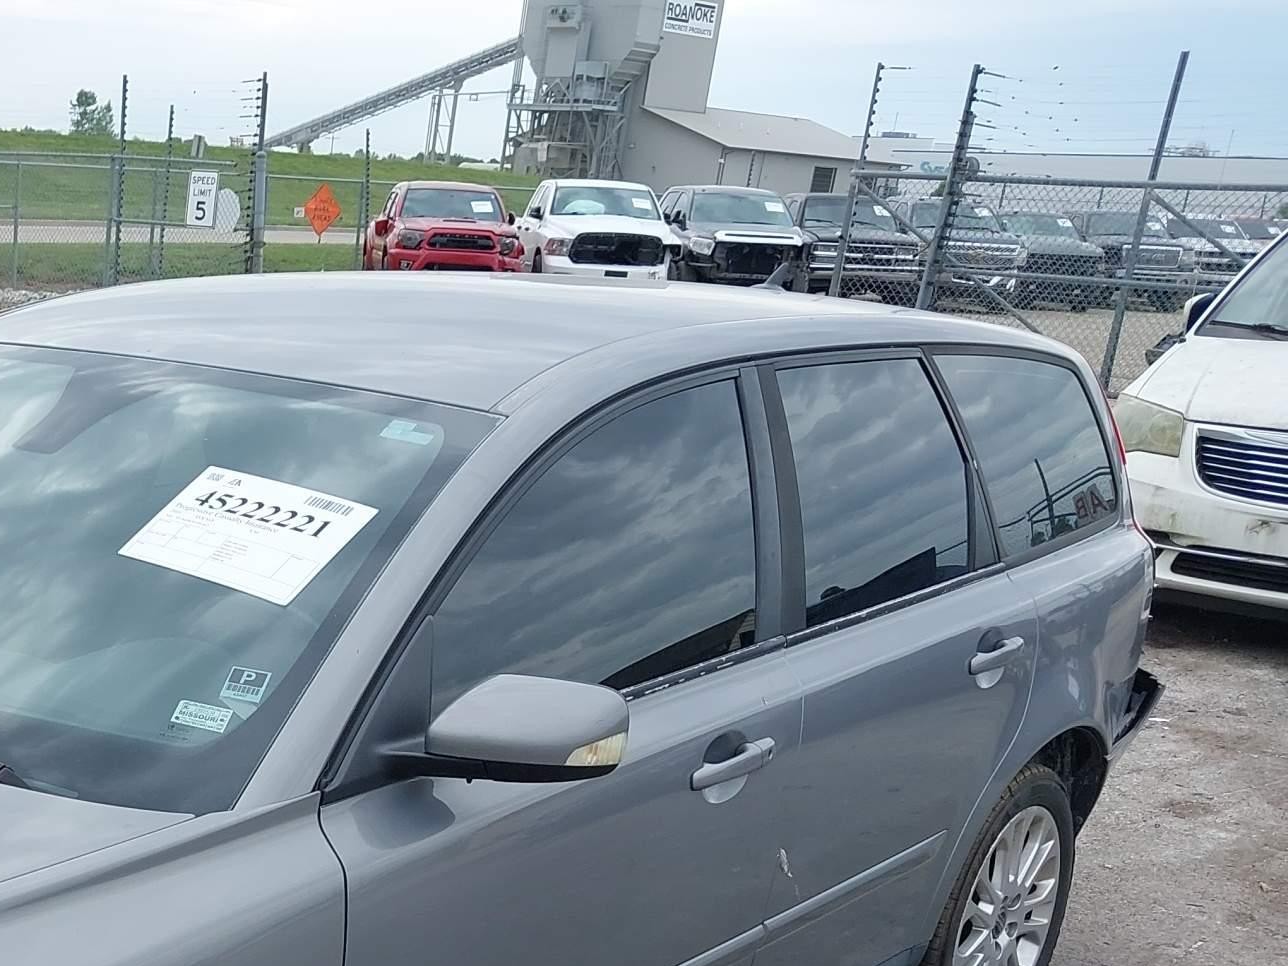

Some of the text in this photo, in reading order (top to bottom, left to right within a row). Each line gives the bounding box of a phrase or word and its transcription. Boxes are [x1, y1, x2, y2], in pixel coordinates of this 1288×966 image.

[667, 2, 715, 23] ROANOKE
[192, 176, 216, 186] SPEED
[193, 188, 212, 198] LIMIT
[194, 201, 206, 221] 5
[194, 490, 332, 539] 45222221
[240, 671, 256, 684] P
[179, 710, 219, 723] MISSOURI
